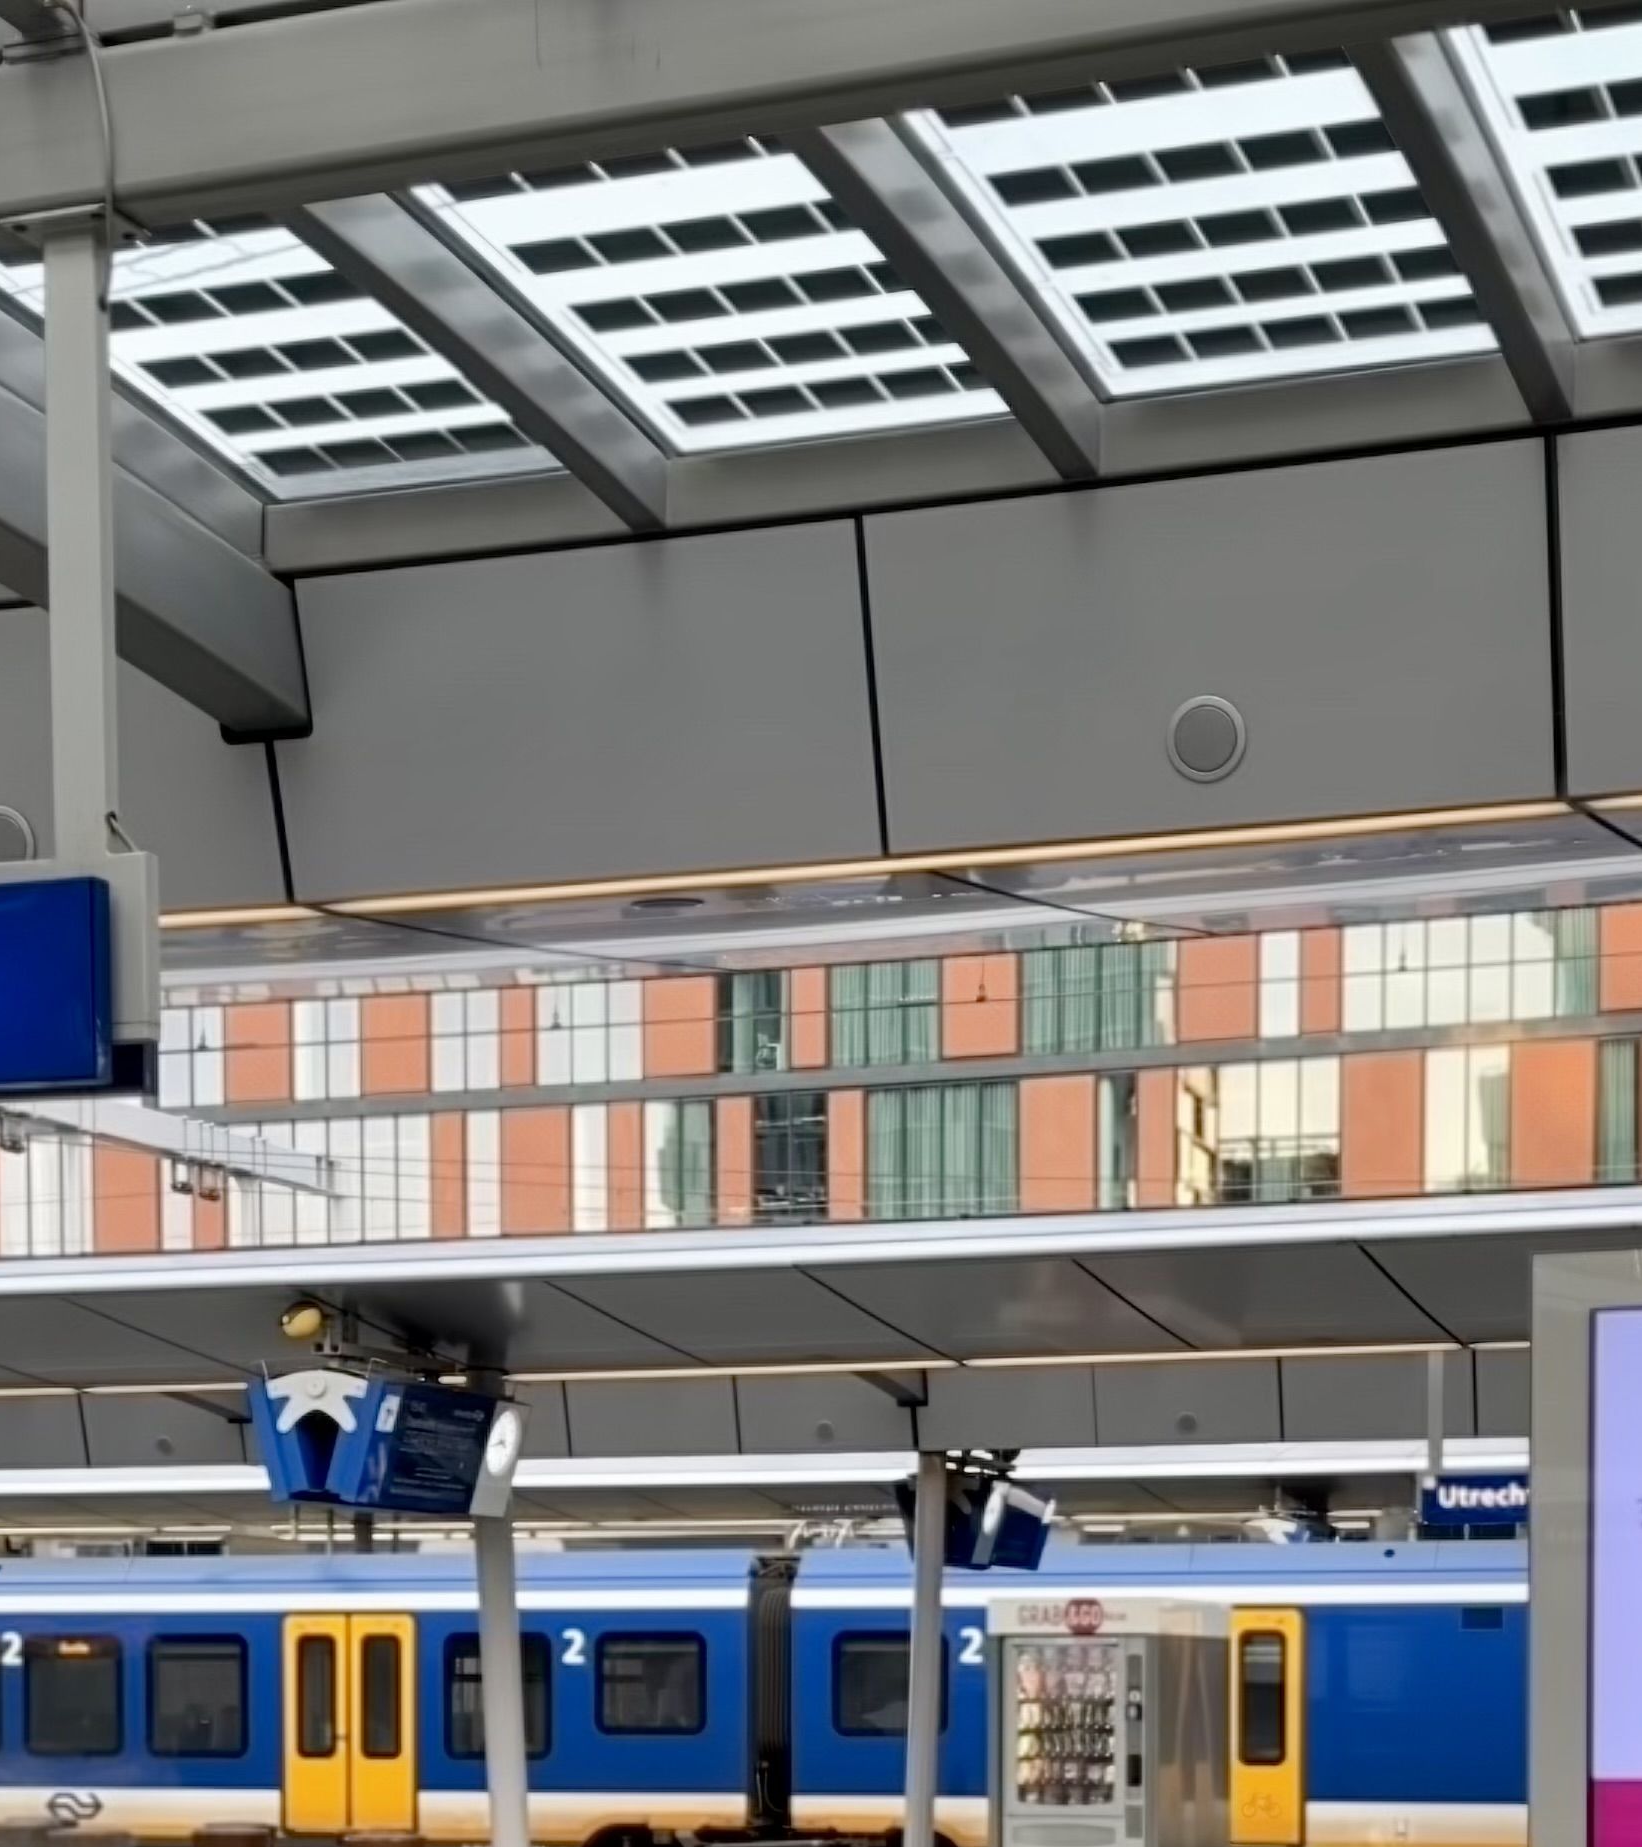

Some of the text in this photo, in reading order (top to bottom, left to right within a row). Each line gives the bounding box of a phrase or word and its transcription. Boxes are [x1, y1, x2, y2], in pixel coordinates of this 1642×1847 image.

[0, 1632, 24, 1666] 2
[562, 1629, 586, 1664] 2
[959, 1628, 984, 1664] 2
